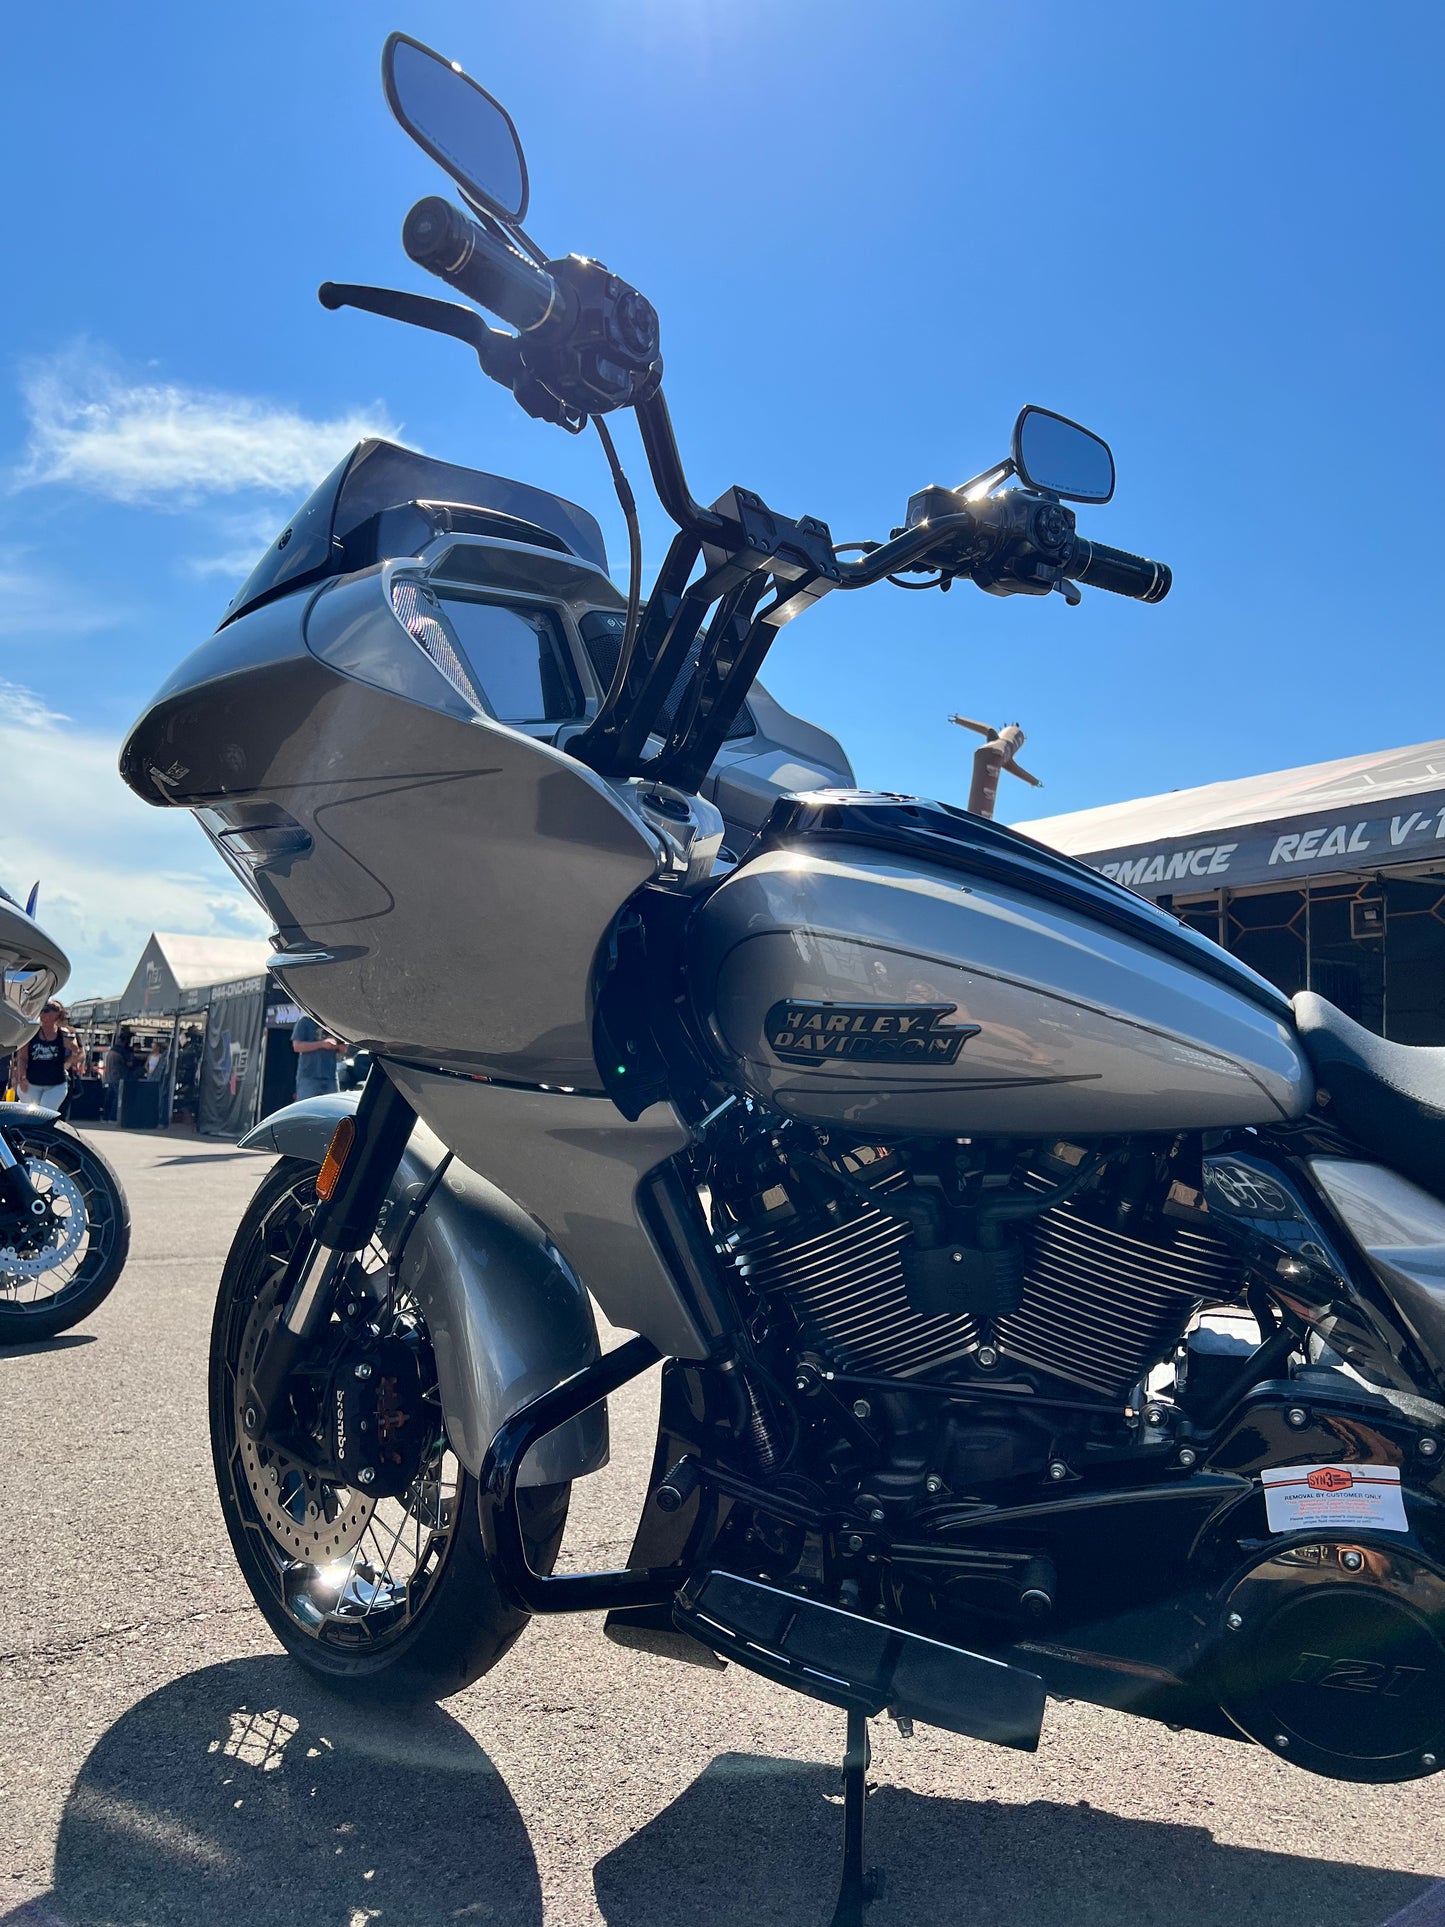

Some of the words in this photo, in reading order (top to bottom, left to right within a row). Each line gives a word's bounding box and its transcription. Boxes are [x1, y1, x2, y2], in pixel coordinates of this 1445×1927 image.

[1092, 843, 1239, 887] RMANCE
[1268, 822, 1370, 865] REAL
[774, 1032, 953, 1055] DAVIDSON
[784, 1012, 925, 1033] HARLEY-
[336, 1390, 346, 1460] brembo
